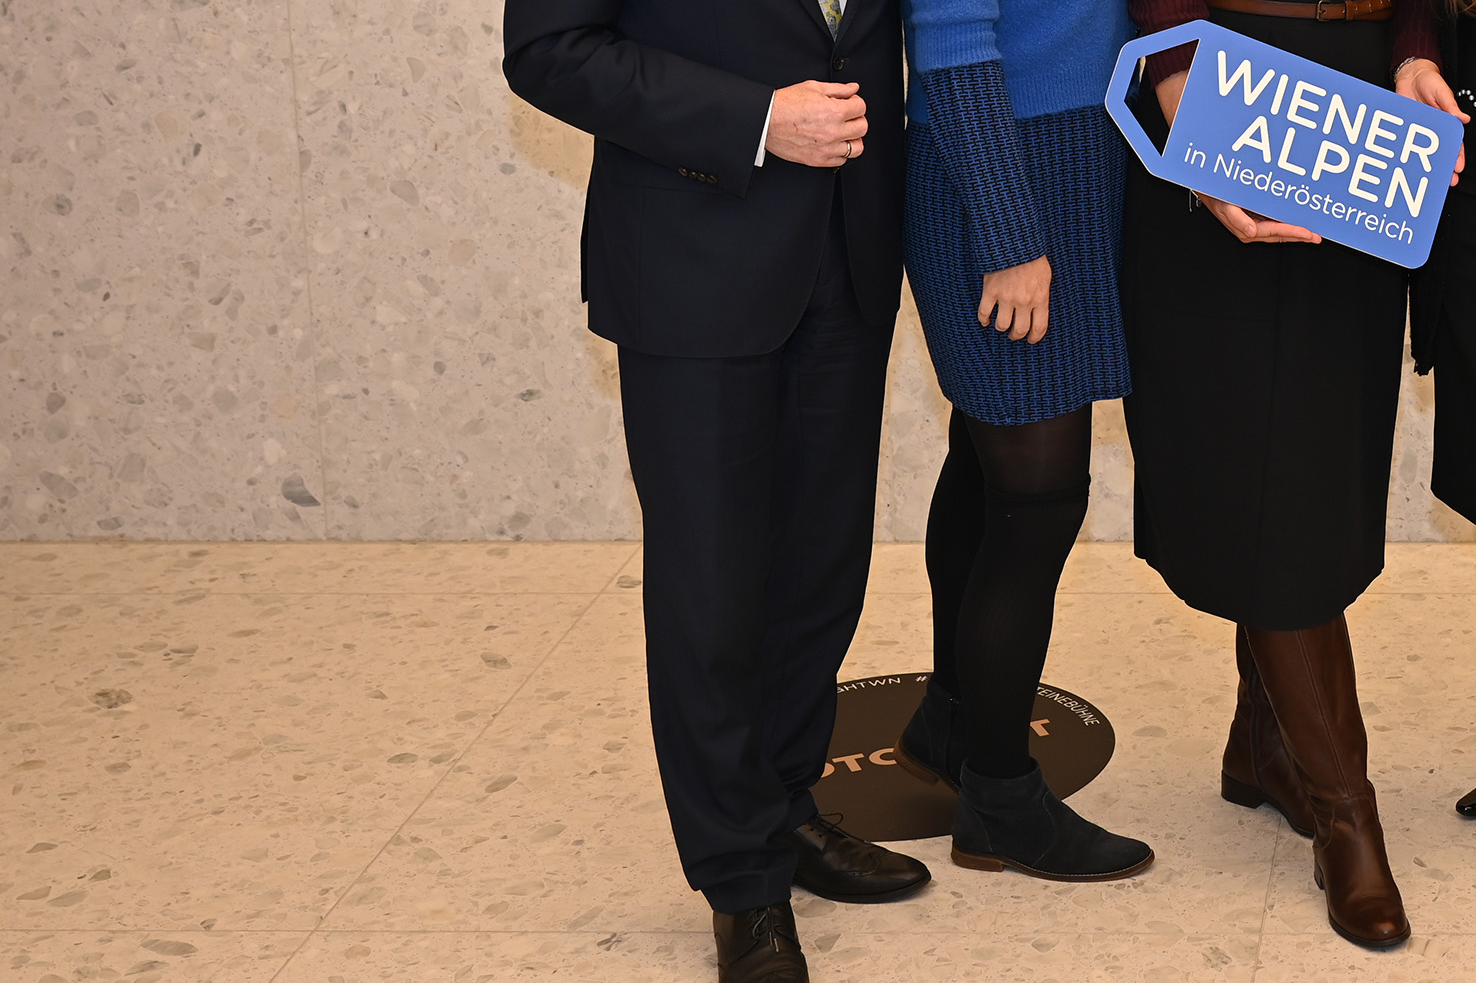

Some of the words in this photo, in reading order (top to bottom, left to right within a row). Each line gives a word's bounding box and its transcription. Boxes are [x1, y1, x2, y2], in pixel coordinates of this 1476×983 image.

[1217, 50, 1440, 173] WIENER
[1184, 142, 1206, 169] in
[1213, 153, 1414, 245] Niederösterreich
[1231, 115, 1429, 218] ALPEN
